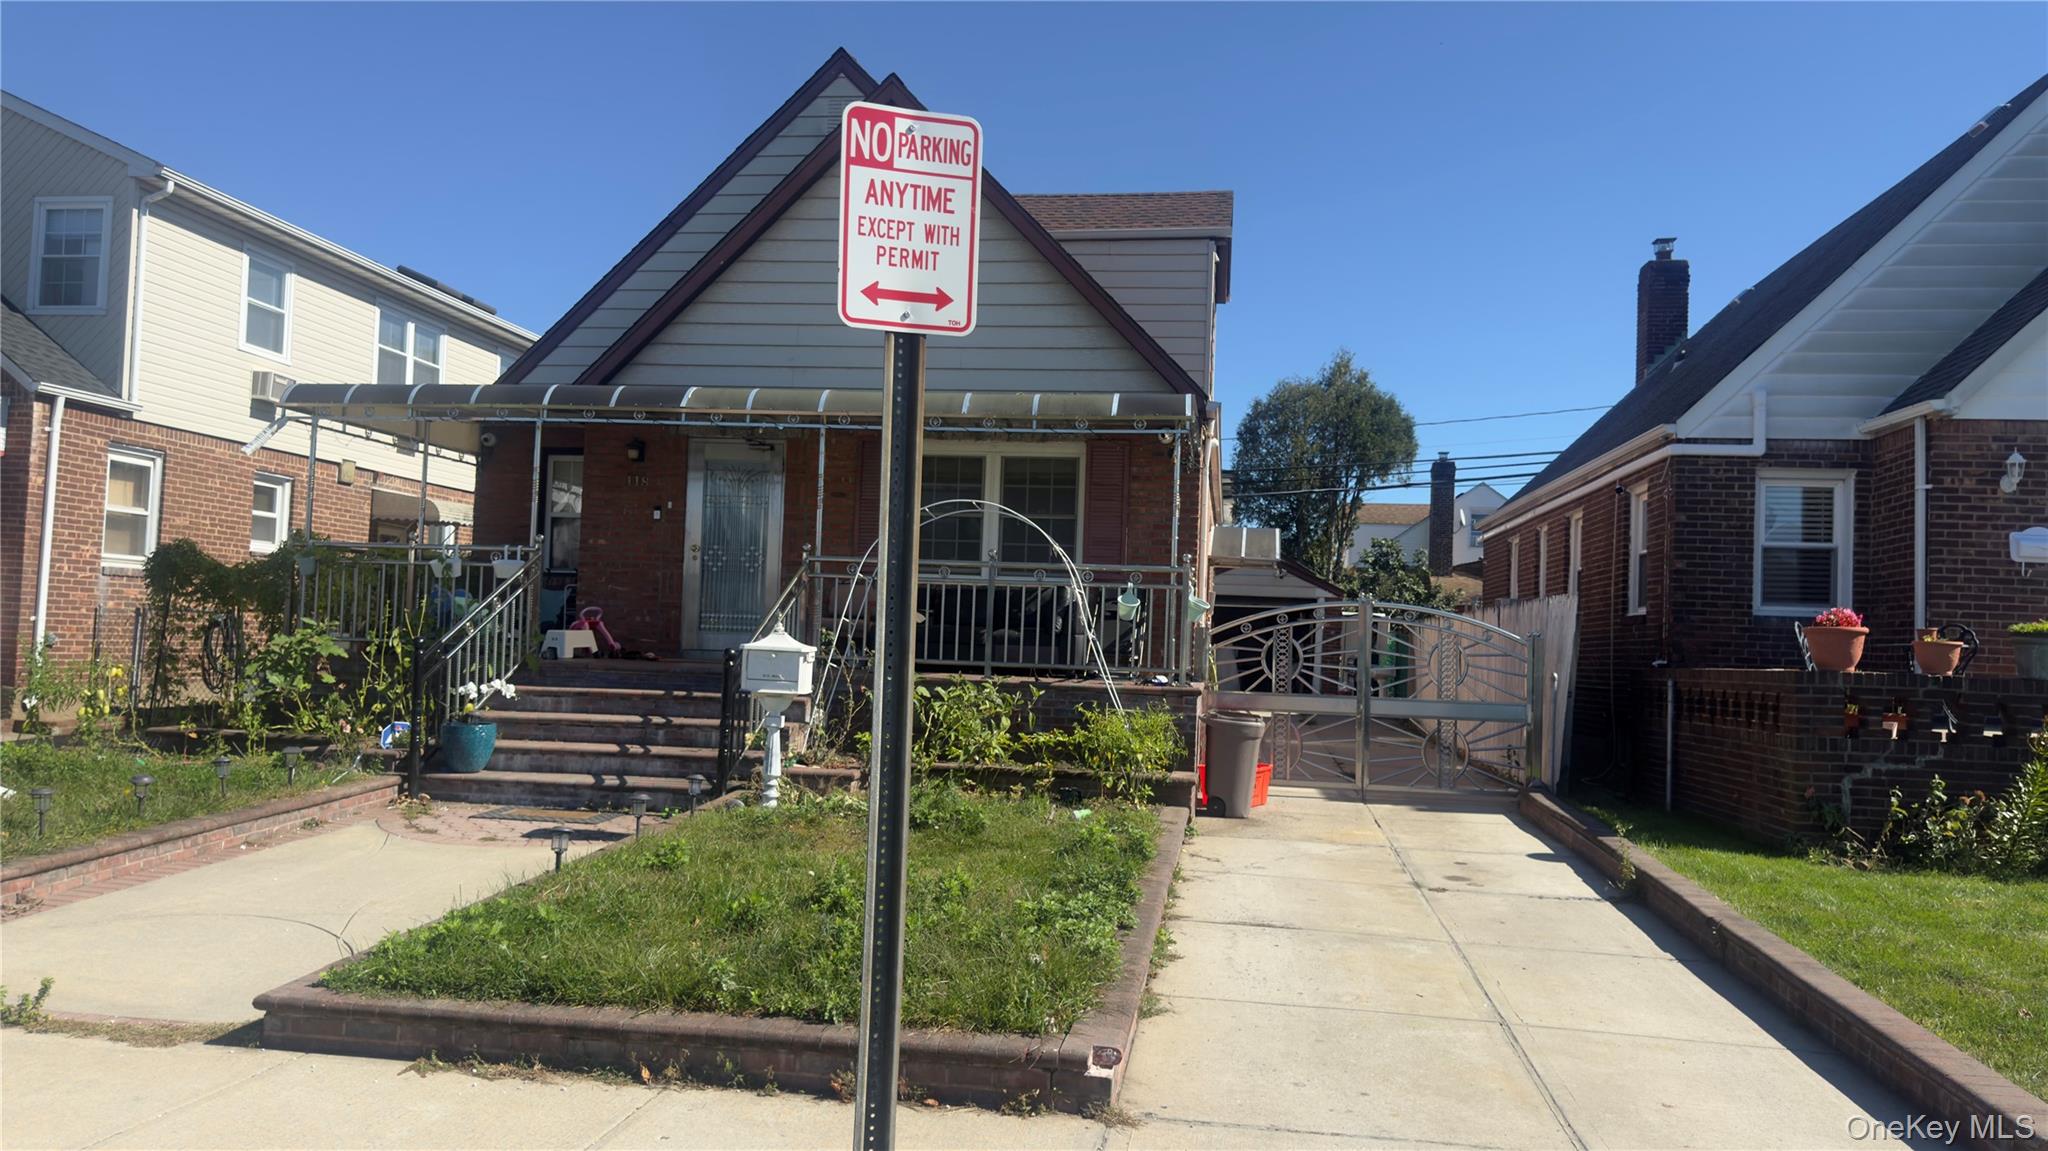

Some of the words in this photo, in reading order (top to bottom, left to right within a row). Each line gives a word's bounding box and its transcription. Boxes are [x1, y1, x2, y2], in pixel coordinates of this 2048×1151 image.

[850, 117, 892, 162] NO
[898, 132, 972, 167] PARKING
[865, 178, 955, 214] ANYTIME
[858, 215, 915, 241] EXCEPT
[924, 223, 960, 246] WITH
[876, 245, 940, 272] PERMIT
[947, 319, 961, 327] TOH
